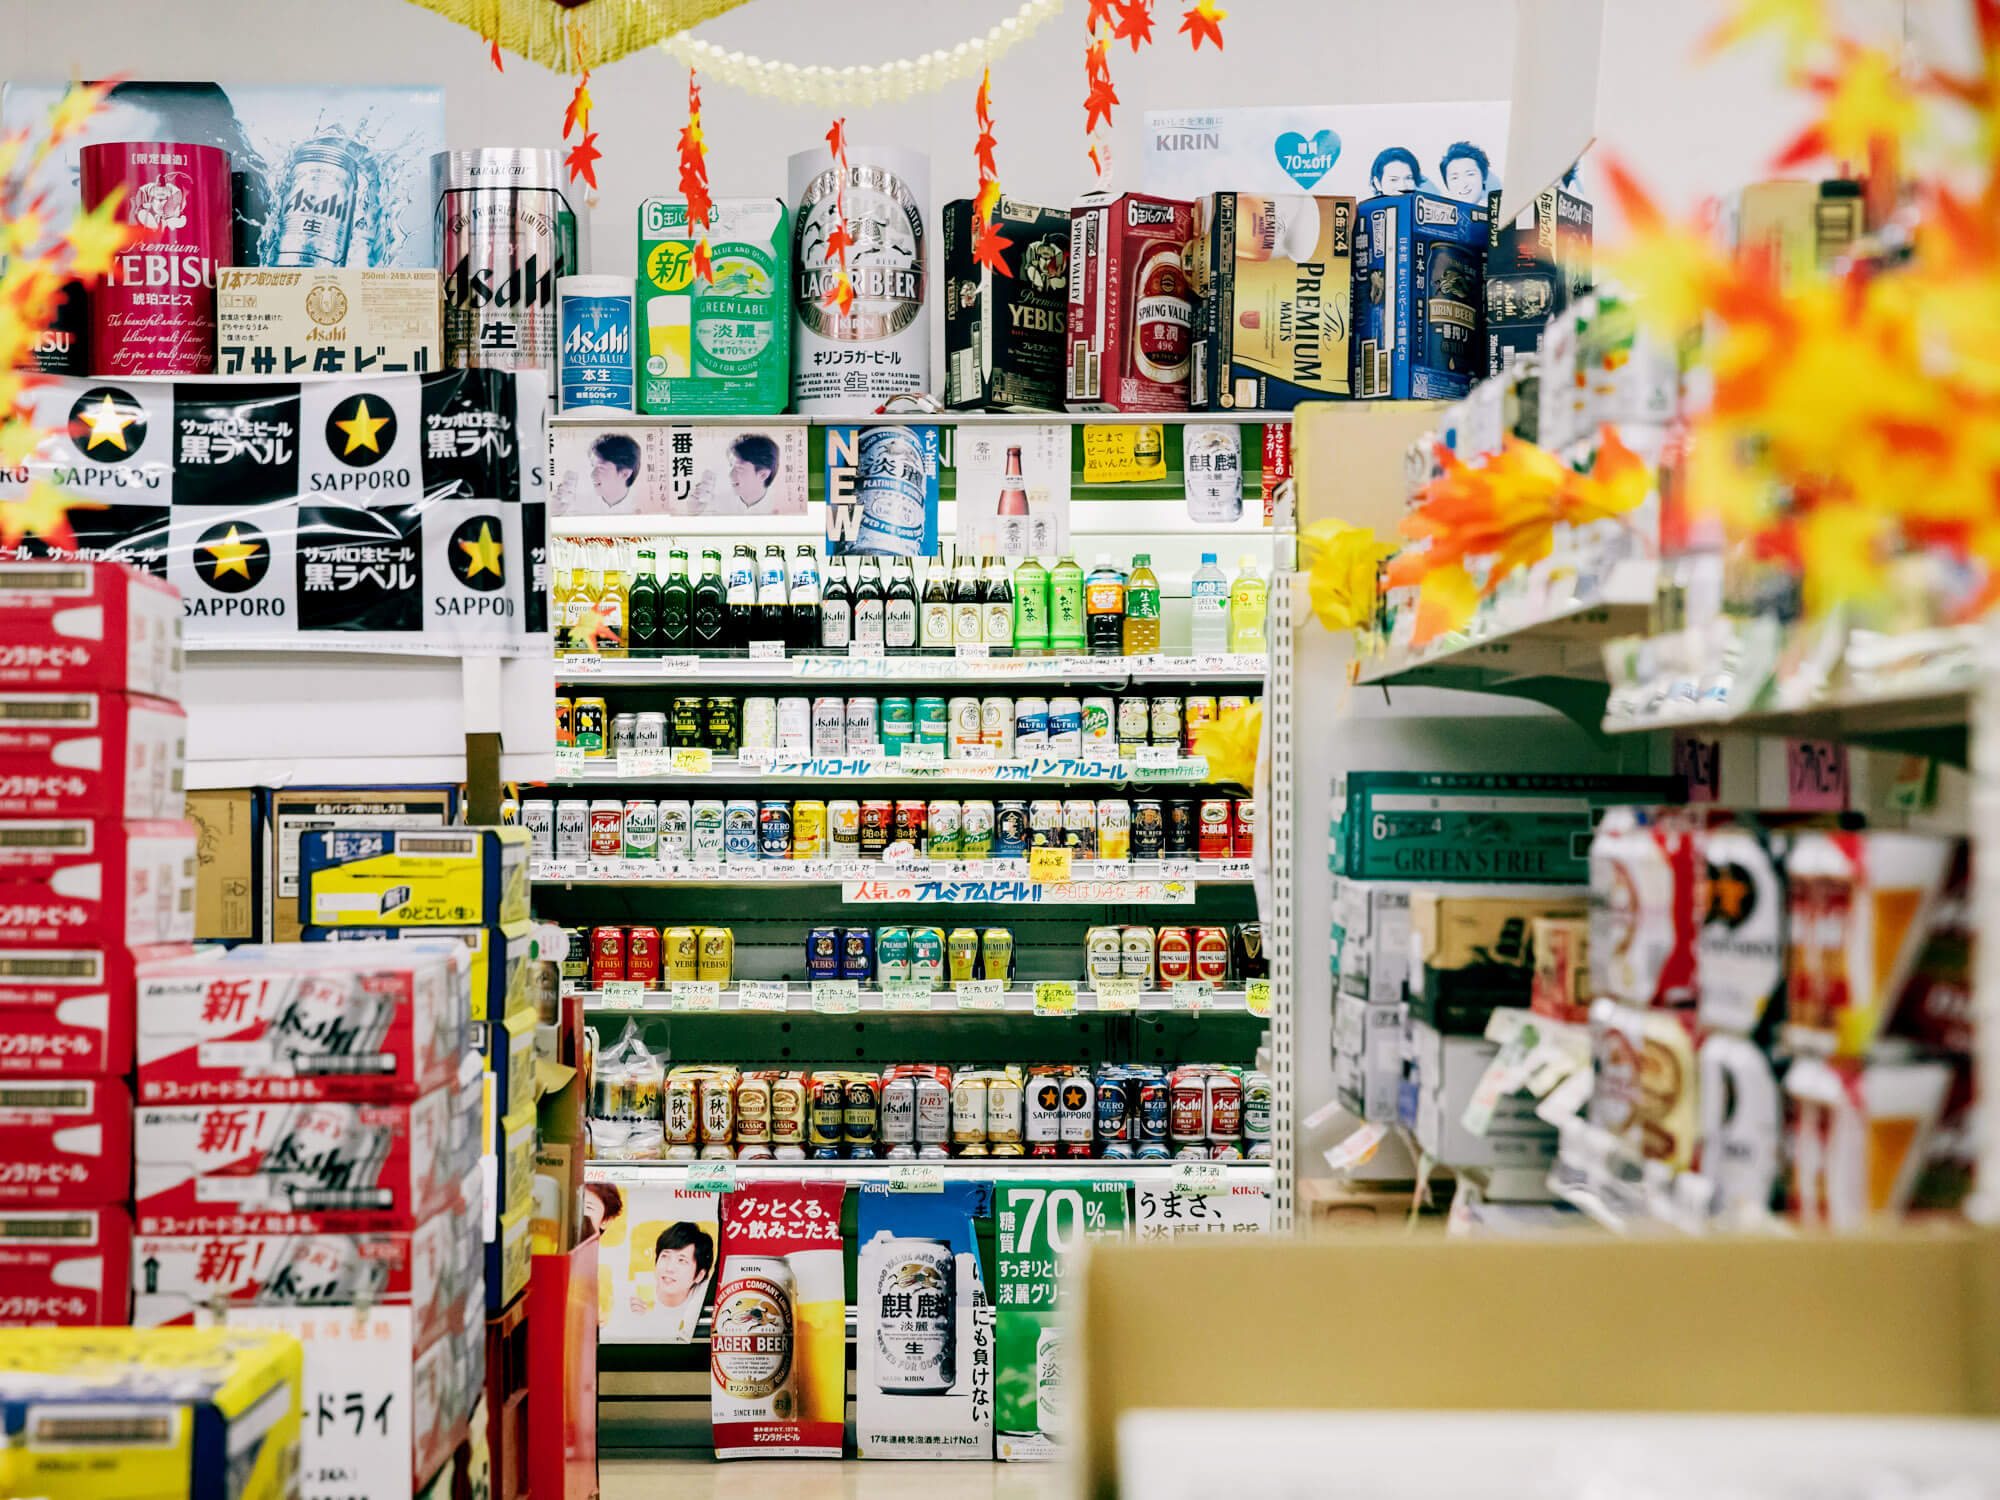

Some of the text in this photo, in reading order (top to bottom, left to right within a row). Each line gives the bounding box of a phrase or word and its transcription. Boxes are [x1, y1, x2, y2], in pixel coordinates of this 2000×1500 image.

[1156, 133, 1220, 152] KIRIN
[1282, 154, 1333, 171] 70%off
[303, 219, 323, 234] 生
[1262, 201, 1276, 251] PREMIUM
[1355, 216, 1369, 283] 一番搾り
[651, 248, 690, 284] 新
[1070, 220, 1082, 302] SPRING VALLEY
[801, 271, 917, 299] LAGR BEER
[699, 301, 769, 315] GREEN LABEL
[1138, 302, 1166, 322] SPRING
[1430, 303, 1453, 316] KIRIN
[1008, 303, 1066, 334] YEBIS
[1279, 301, 1294, 343] MALT'S
[1293, 262, 1327, 383] PREMIUM
[304, 326, 347, 343] Asahi
[480, 320, 518, 350] 生
[564, 323, 629, 355] Asahi
[712, 323, 756, 339] 淡麗
[1153, 324, 1179, 341] 豊潤
[567, 352, 626, 365] AQUA BLUE
[812, 349, 902, 366] キリンラガービール
[581, 368, 612, 382] 本生
[843, 370, 870, 392] 生
[179, 418, 294, 438] サッポロ生ビール
[426, 411, 511, 430] サッポロ生ル
[179, 434, 294, 466] 黒ラベル
[1189, 453, 1238, 473] 麒麟
[310, 468, 411, 492] SAPPORO
[826, 429, 865, 542] NEW
[303, 546, 416, 563] サッポロ生ビール
[303, 563, 416, 592] 黒ラベル
[183, 597, 286, 618] SAPPORO
[815, 716, 841, 728] Asahi
[1030, 757, 1129, 780] ノンアルコール
[557, 822, 584, 833] Asahi
[592, 820, 620, 833] Asahi
[626, 812, 657, 827] Asahi
[701, 960, 729, 969] YEBISU
[883, 1101, 912, 1113] Asahi
[919, 1097, 944, 1106] DRY
[1172, 1097, 1201, 1112] Asahi
[671, 1098, 688, 1132] 秋味
[709, 1098, 726, 1132] 秋味
[737, 1121, 765, 1131] CLASSIC
[673, 1189, 712, 1199] KIRIN
[1092, 1182, 1128, 1193] KIRIN
[738, 1197, 831, 1219] グッとくる、
[1140, 1190, 1222, 1220] うまさ、
[999, 1211, 1016, 1254] 糖質
[886, 1254, 914, 1273] VALUE
[745, 1279, 780, 1300] COMPANY,
[881, 1292, 951, 1319] 麒麟
[899, 1320, 929, 1332] 淡麗
[712, 1335, 789, 1353] LAGER BEER
[904, 1341, 925, 1355] 生
[897, 1358, 919, 1372] FOR
[733, 1408, 752, 1418] SINCE
[753, 1432, 801, 1442] キリンラガービール
